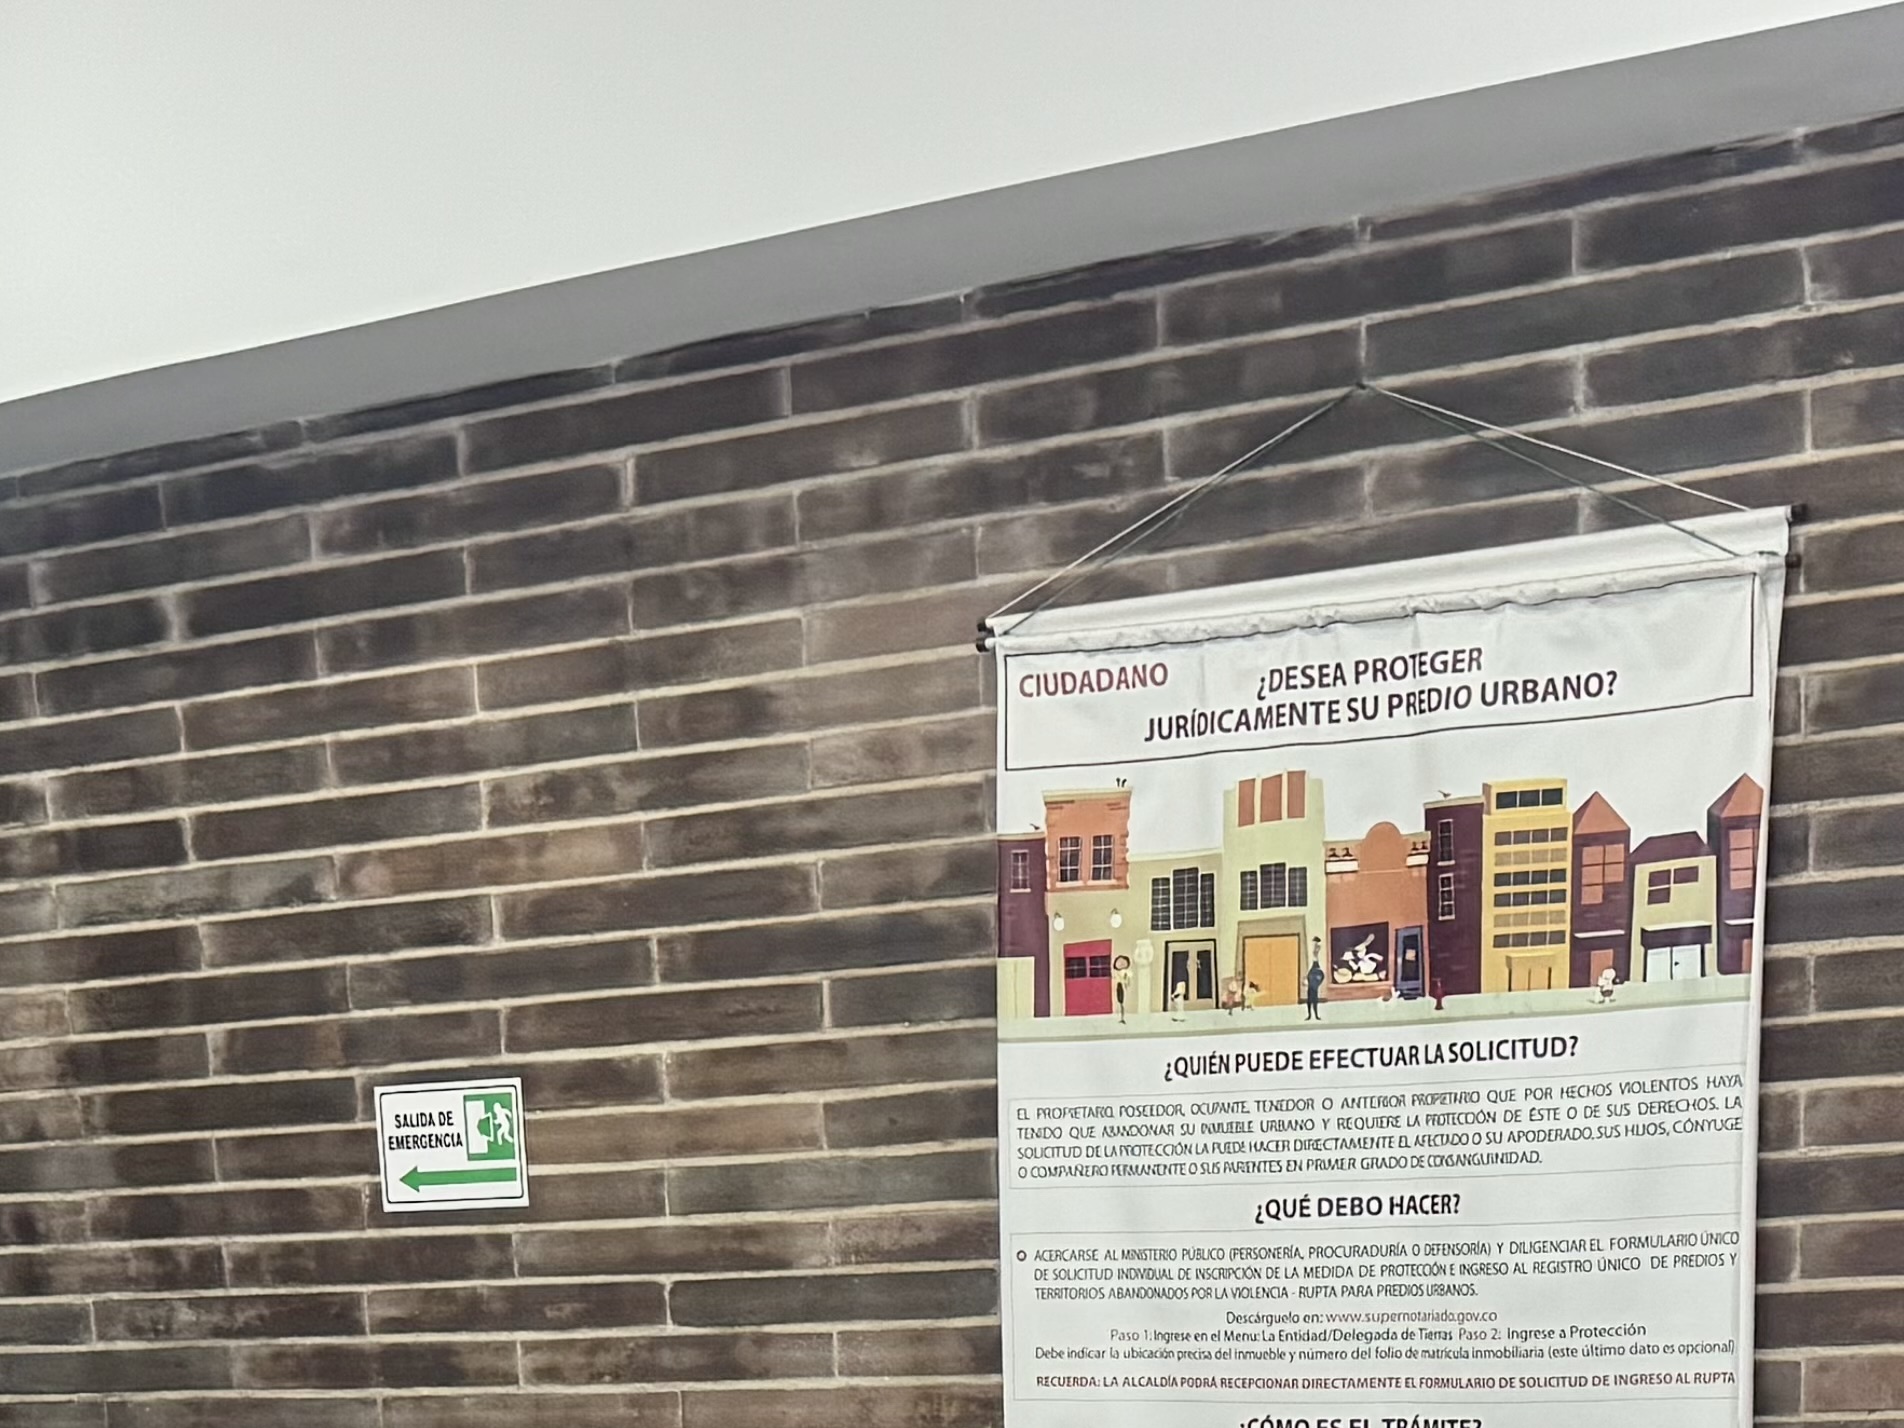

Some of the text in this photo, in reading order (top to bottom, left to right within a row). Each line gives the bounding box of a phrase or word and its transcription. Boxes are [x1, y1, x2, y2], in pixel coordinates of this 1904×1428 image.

[1019, 663, 1169, 698] CIUDADANO
[1258, 647, 1483, 699] ¿DESEA PROTEGER
[1147, 671, 1618, 741] JURÍDICAMENTE SU PREDIO URBANO?
[1165, 1036, 1579, 1080] ¿QUIÉN PUEDE EFECTUAR LA SOLICITUD?
[1486, 1088, 1517, 1104] QUE
[1559, 1082, 1613, 1099] HECHOS
[1618, 1076, 1699, 1095] VIOLENTOS
[394, 1110, 453, 1129] SALIDA DE
[1528, 1106, 1561, 1122] ÉSTE
[1583, 1104, 1601, 1120] DE
[1606, 1102, 1631, 1118] SUS
[388, 1131, 464, 1151] EMERGENCIA
[1017, 1145, 1083, 1160] SOLICITUD
[1595, 1124, 1622, 1140] SUS
[1255, 1193, 1461, 1224] ¿QUÉ DEBO HACER?
[1033, 1248, 1099, 1263] ACERCARSE
[1103, 1249, 1119, 1262] AL
[1181, 1246, 1226, 1261] PÚBLICO
[1411, 1243, 1421, 1257] O
[1496, 1242, 1504, 1255] Y
[1509, 1238, 1587, 1255] DILIGENCIAR
[1589, 1238, 1605, 1252] EL
[1609, 1233, 1698, 1251] FORMULARIO
[1700, 1230, 1740, 1246] ÚNICO
[1033, 1253, 1740, 1282] DE SOLICITUD DE DE LA MEDIDA DE E INGRESO AL REGISTRO ÚNICO DE PREDIOS Y
[1034, 1286, 1106, 1300] TERRITORIOS
[1107, 1286, 1189, 1300] ABANDONADOS
[1214, 1286, 1229, 1300] LA
[1298, 1285, 1338, 1299] RUPTA
[1340, 1284, 1374, 1298] PARA
[1376, 1283, 1425, 1298] PREDIOS
[1226, 1310, 1301, 1326] Descárguelo
[1110, 1328, 1140, 1342] Paso
[1153, 1329, 1192, 1345] Ingrese
[1193, 1332, 1208, 1343] en
[1210, 1329, 1221, 1342] el
[1278, 1328, 1398, 1344] Entidad/Delegada
[1400, 1327, 1416, 1341] de
[1458, 1327, 1488, 1341] Paso
[1507, 1327, 1556, 1342] Ingrese
[1558, 1328, 1567, 1339] a
[1569, 1323, 1647, 1339] Protección
[1214, 1347, 1232, 1361] del
[1298, 1348, 1348, 1361] número
[1350, 1346, 1372, 1360] del
[1374, 1345, 1403, 1360] folio
[1404, 1346, 1420, 1360] de
[1471, 1345, 1545, 1360] inmobiliaria
[1628, 1341, 1660, 1356] dato
[1102, 1376, 1119, 1388] LA
[1121, 1375, 1179, 1388] ALCALDÍA
[1219, 1377, 1299, 1390] RECEPCIONAR
[1301, 1376, 1402, 1390] DIRECTAMENTE
[1404, 1376, 1417, 1389] EL
[1419, 1376, 1496, 1390] FORMULARIO
[1498, 1376, 1516, 1389] DE
[1518, 1375, 1589, 1389] SOLICITUD
[1591, 1374, 1610, 1387] DE
[1613, 1372, 1673, 1386] INGRESO
[1675, 1372, 1691, 1385] AL
[1693, 1371, 1736, 1385] RUPTA
